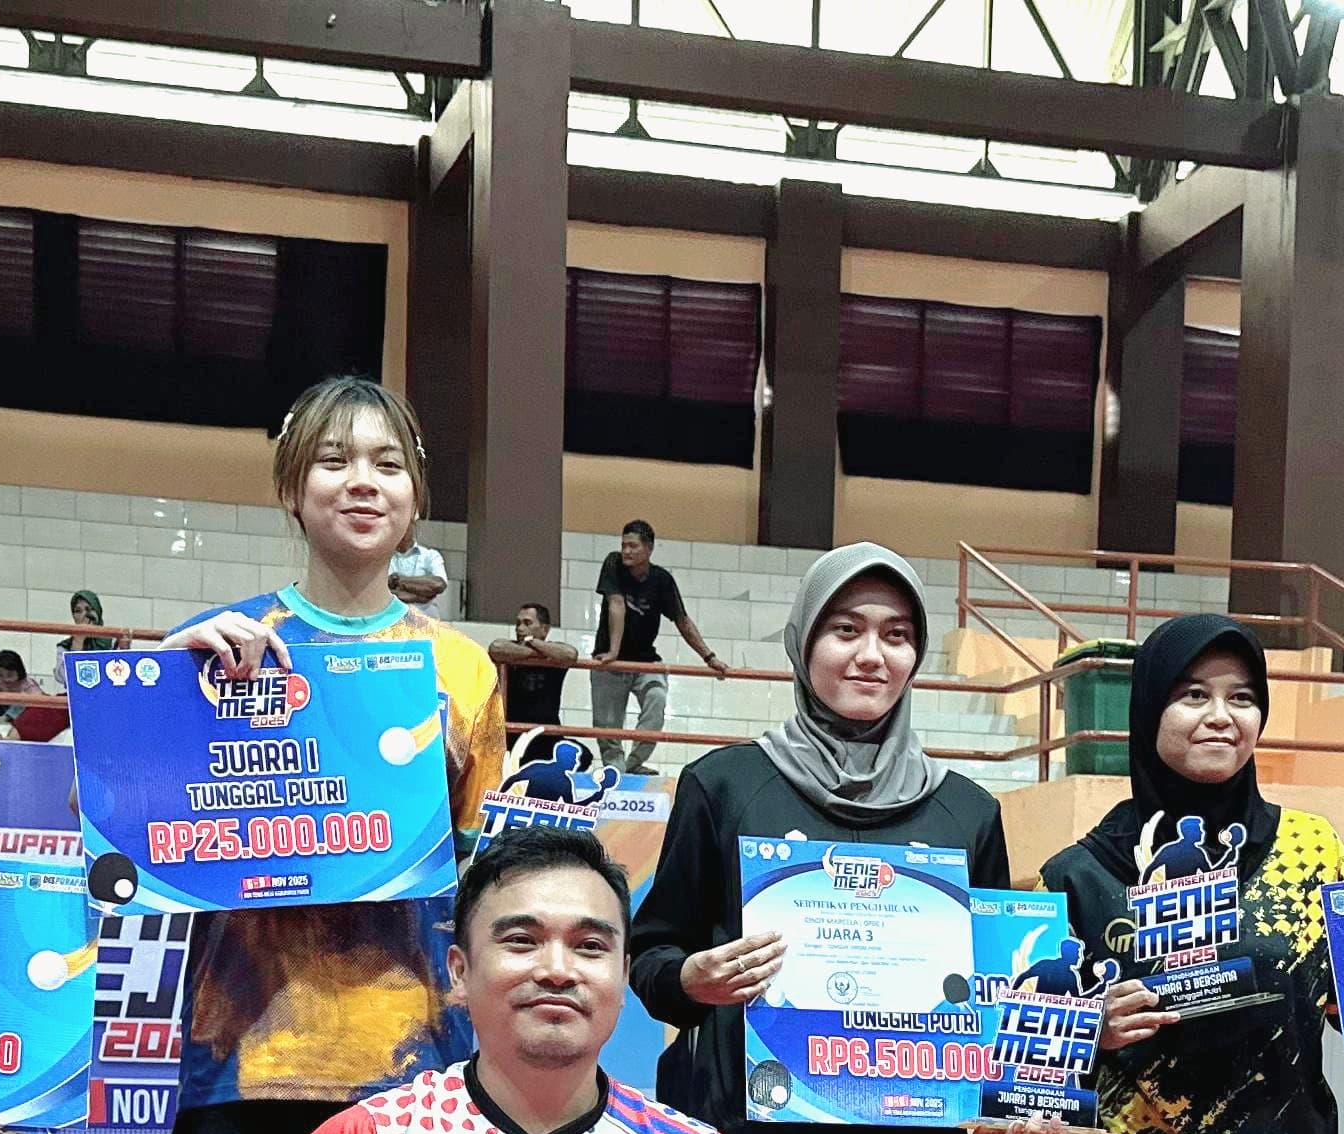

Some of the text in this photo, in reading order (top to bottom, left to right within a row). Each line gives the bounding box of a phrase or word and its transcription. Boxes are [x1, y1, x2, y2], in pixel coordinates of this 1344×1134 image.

[216, 677, 287, 697] TENIS
[218, 697, 286, 717] MEJA
[211, 739, 319, 773] JUARA I
[188, 777, 346, 809] TUNGGAL PUTRI
[484, 791, 598, 817] BUPATI PASER OPEN
[149, 813, 391, 863] RP25.000.000
[833, 875, 879, 889] MEJA
[834, 862, 880, 876] TENIS
[1130, 868, 1236, 897] BUPATI PASER OPEN
[1131, 880, 1237, 927] TENIS
[816, 926, 874, 942] JUARA 3
[1138, 911, 1237, 961] MEJA
[1166, 947, 1216, 969] 2025
[1152, 970, 1238, 996] JUARA 3 BERSAMA
[999, 989, 1036, 1002] BUPATI
[1039, 993, 1073, 1006] PASER
[1074, 998, 1103, 1010] OPEN
[999, 1002, 1101, 1040] TENIS
[104, 1022, 181, 1058] 20
[993, 1033, 1096, 1073] MEJA
[809, 1036, 1004, 1081] RP6.500.000
[1016, 1066, 1066, 1084] 2025
[112, 1088, 170, 1124] NOV
[998, 1091, 1080, 1111] JUARA 3 BERSAMA
